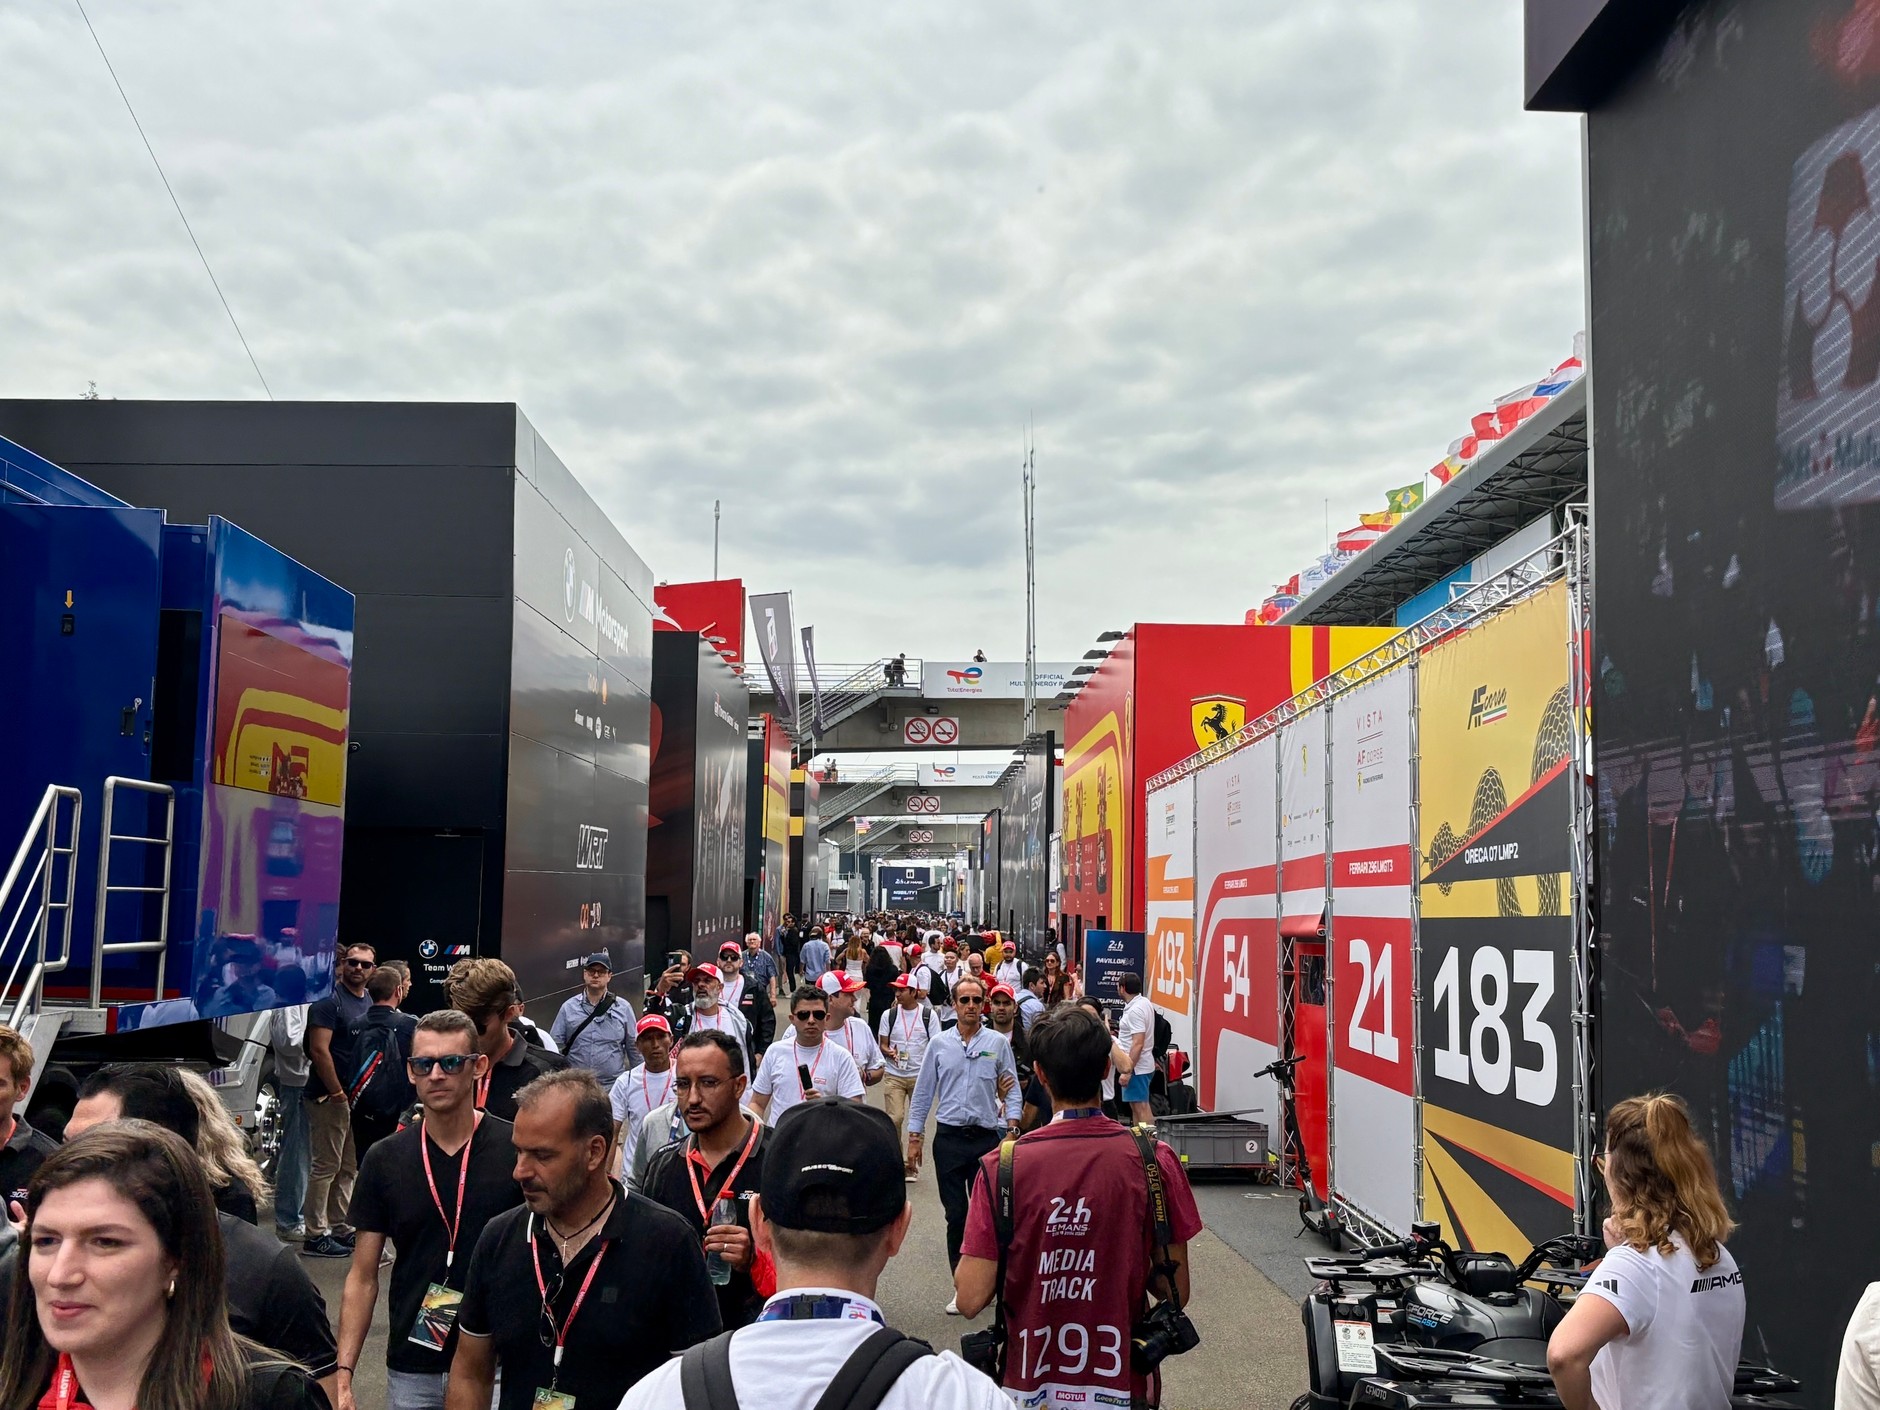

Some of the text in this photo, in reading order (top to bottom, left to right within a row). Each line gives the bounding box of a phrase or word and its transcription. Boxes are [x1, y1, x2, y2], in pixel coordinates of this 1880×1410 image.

[596, 593, 628, 654] Motorsport
[1357, 710, 1383, 731] VISTA
[1357, 750, 1366, 765] AF
[1464, 843, 1518, 864] ORECA 07 LMP2
[1096, 957, 1126, 965] PAVILLON
[1156, 930, 1185, 998] 193
[1223, 934, 1250, 1017] 54
[1349, 939, 1399, 1063] 21
[1434, 946, 1558, 1106] 183
[1248, 1142, 1255, 1151] 2
[1155, 1193, 1164, 1222] Nikon
[1038, 1249, 1095, 1275] MEDIA
[1041, 1277, 1097, 1304] TRACK
[1019, 1322, 1122, 1379] 1293
[1057, 1392, 1085, 1401] MOTUL
[1365, 1384, 1387, 1400] CFMOTO
